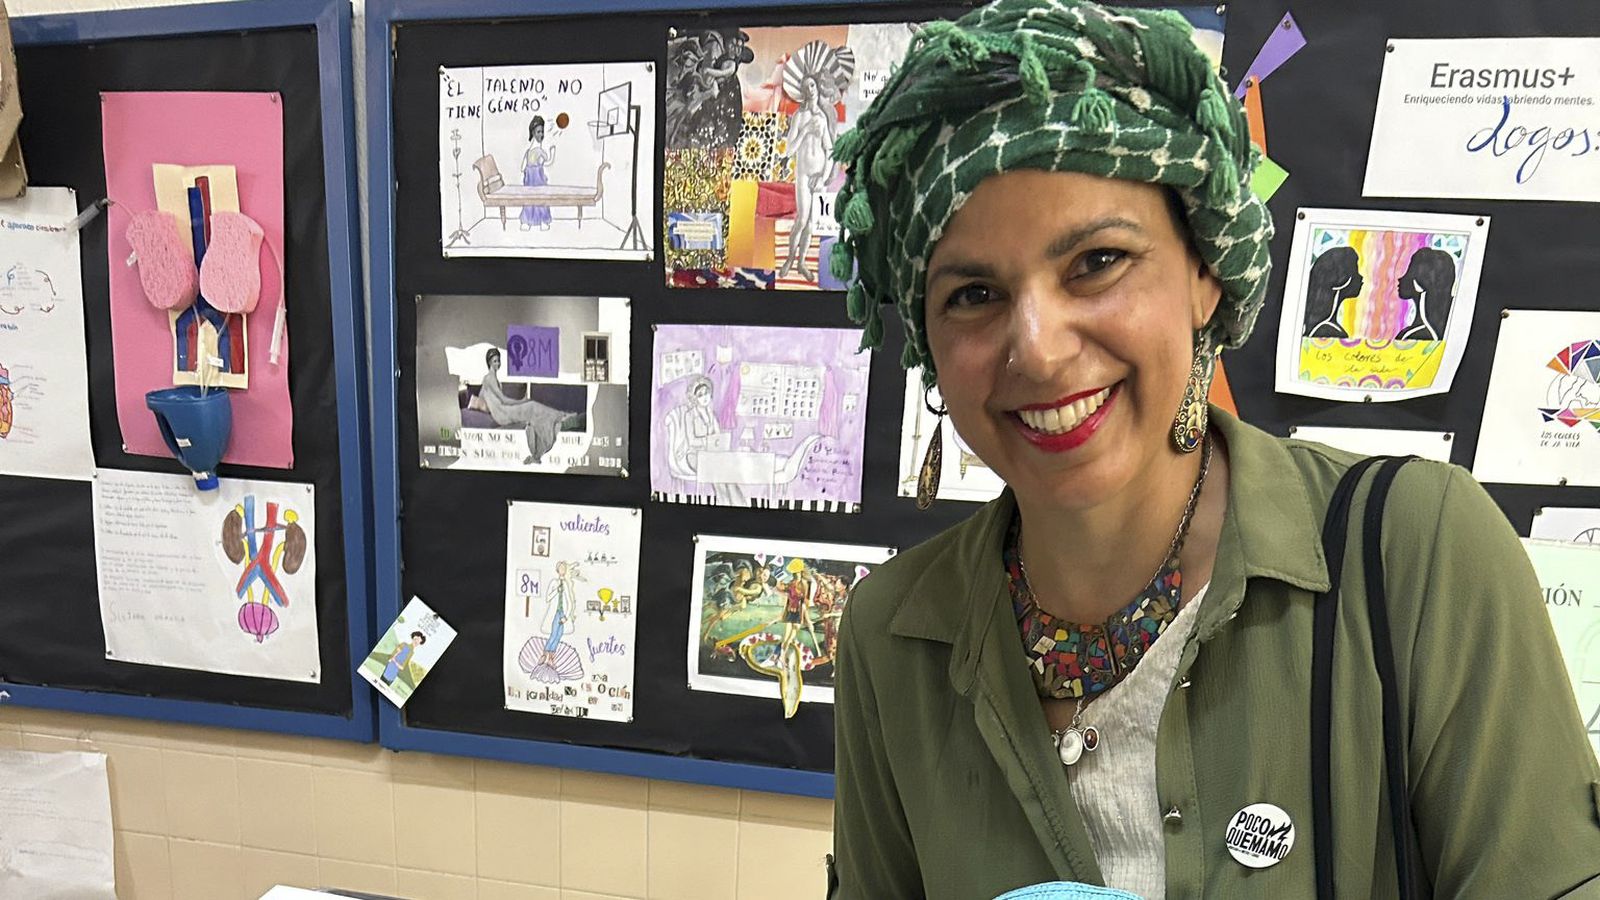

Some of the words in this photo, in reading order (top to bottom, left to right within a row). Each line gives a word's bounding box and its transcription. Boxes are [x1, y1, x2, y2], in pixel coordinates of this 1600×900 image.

[486, 78, 545, 95] TALENTO
[558, 79, 583, 95] NO
[1430, 62, 1575, 89] Erasmus+
[445, 104, 481, 119] TIENE
[1404, 93, 1474, 105] Enriqueciendo
[1553, 96, 1595, 106] mentes.
[526, 338, 554, 371] 8M
[560, 514, 610, 536] valientes
[520, 573, 540, 595] 8M
[586, 635, 626, 663] fuertes
[1235, 810, 1271, 836] POCO
[1226, 826, 1289, 861] QUEMAMO
